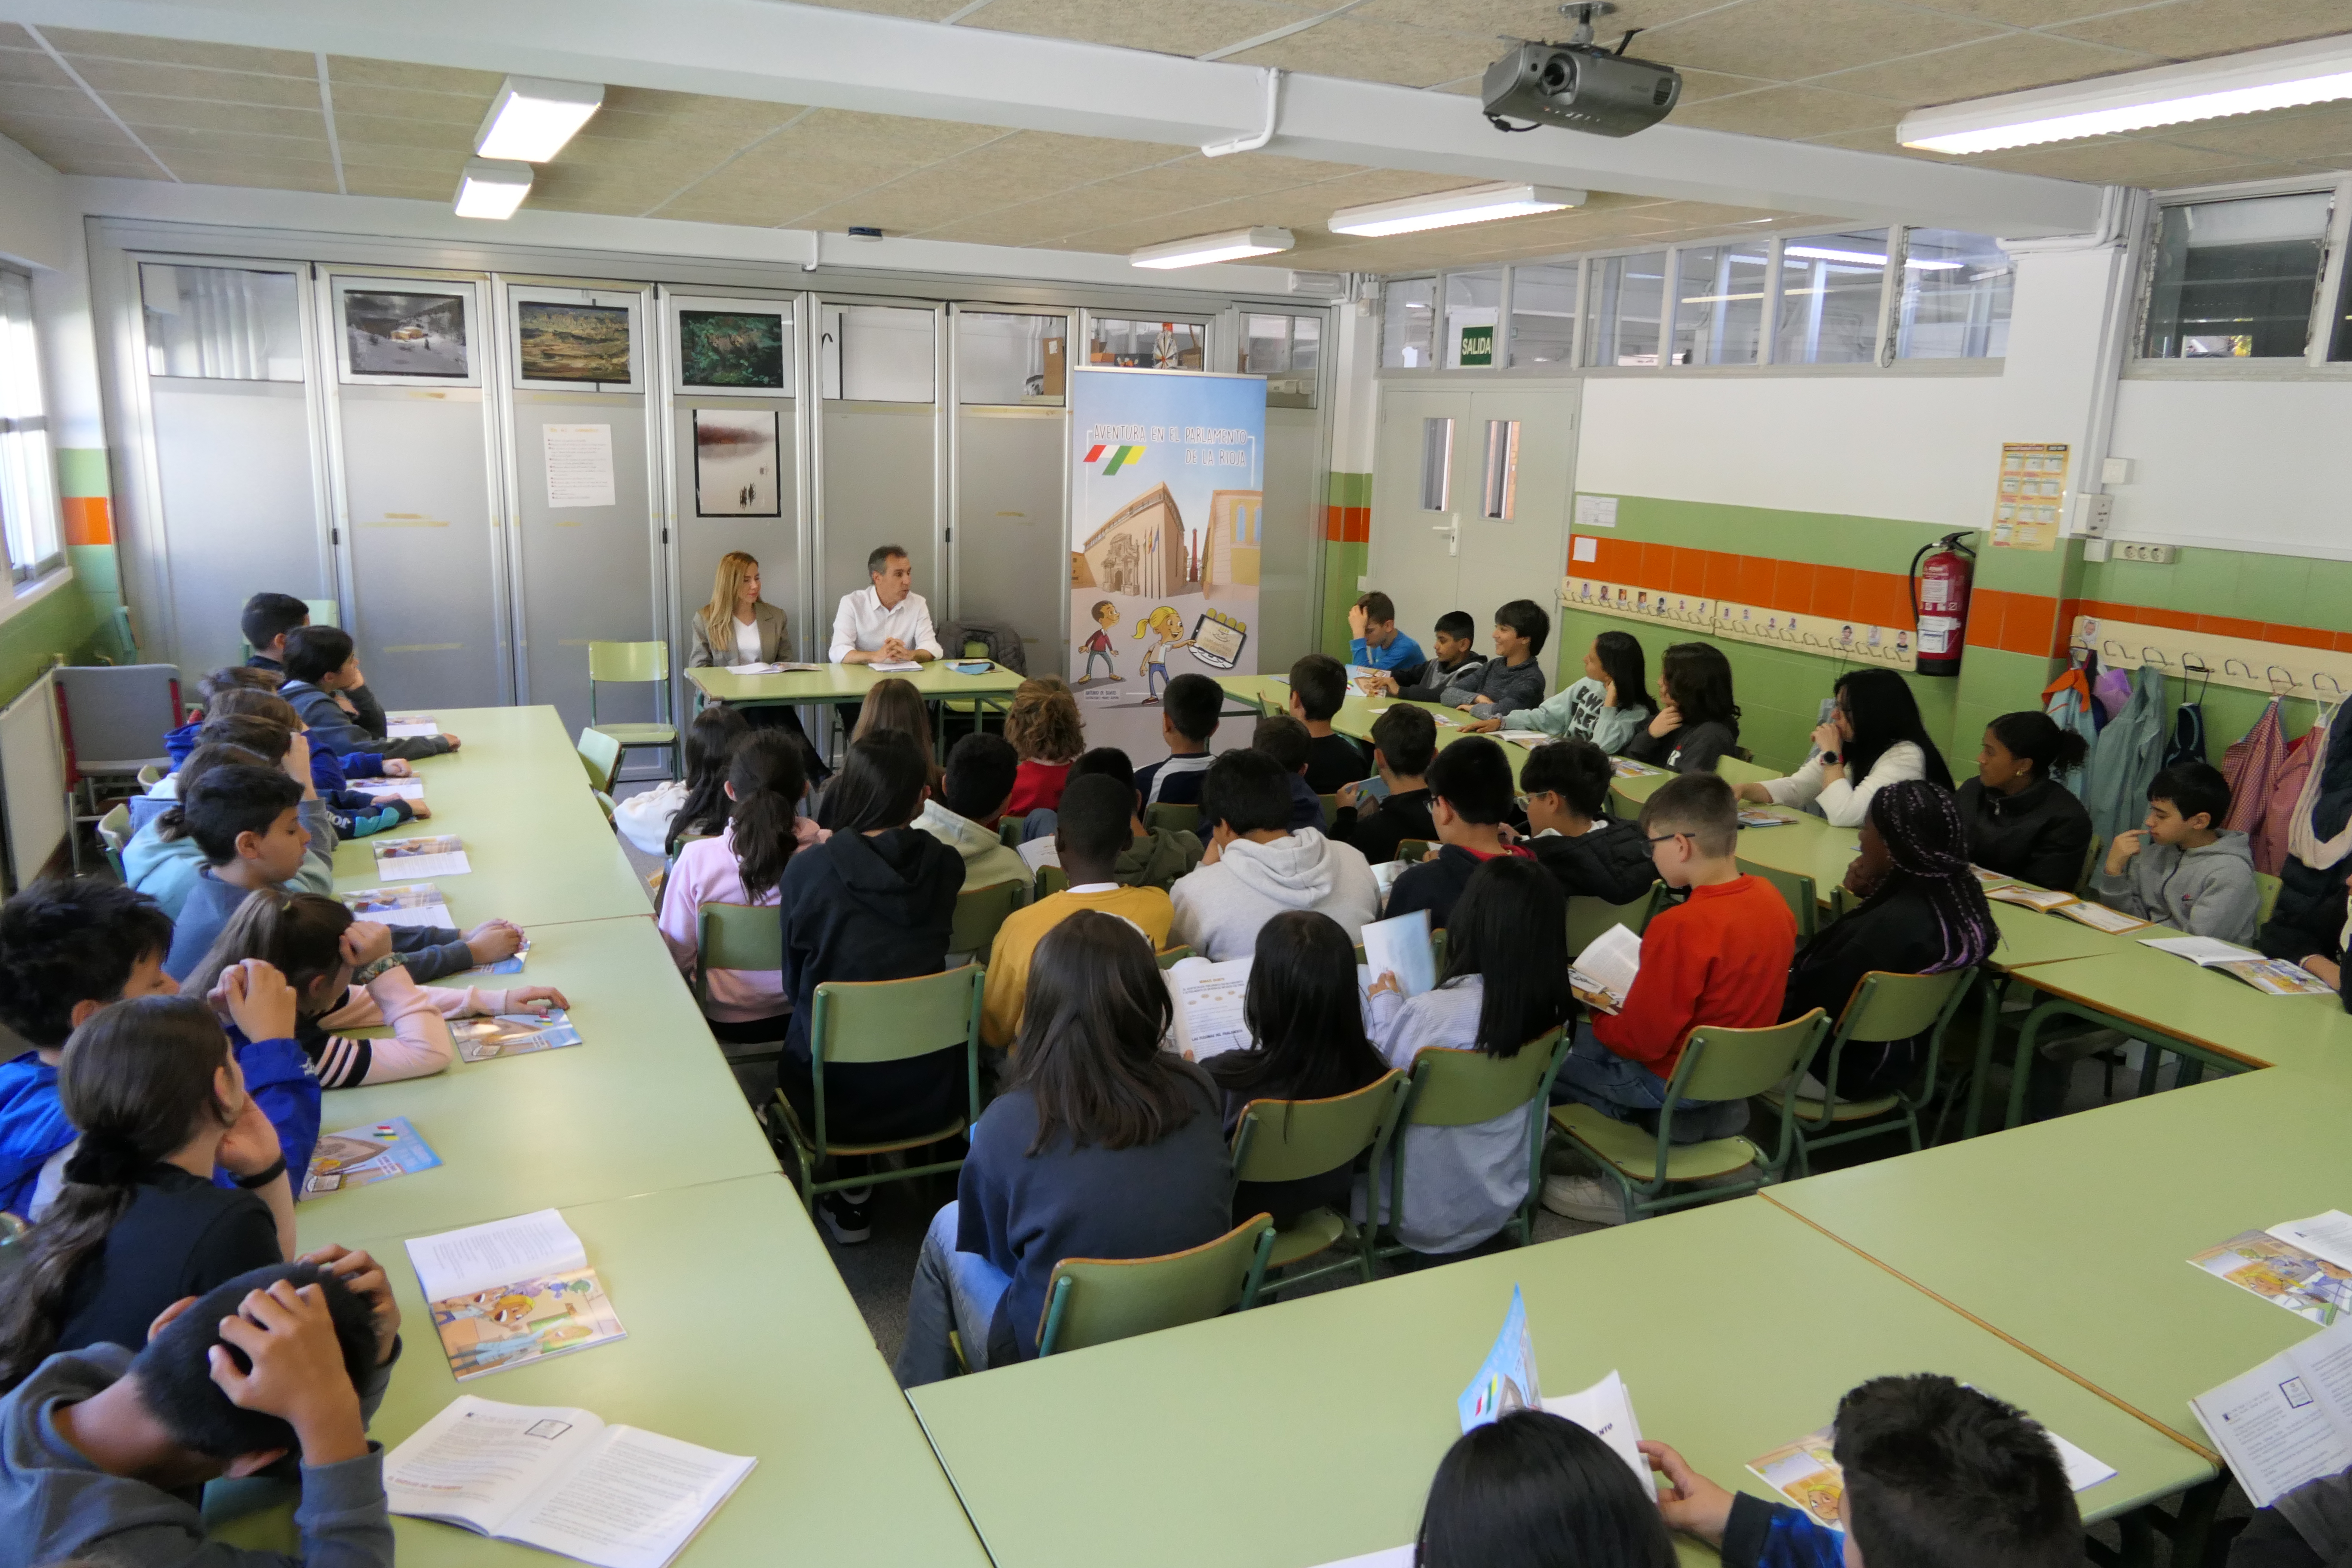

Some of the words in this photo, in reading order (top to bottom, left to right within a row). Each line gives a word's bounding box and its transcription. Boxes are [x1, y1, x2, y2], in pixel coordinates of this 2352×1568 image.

[1462, 337, 1491, 355] SALIDA
[1094, 425, 1146, 441] AVENTURA
[1152, 427, 1164, 442] EN
[1170, 427, 1179, 442] EL
[1185, 427, 1246, 444] PARLAMENTO
[1186, 449, 1197, 464] DE
[1203, 450, 1213, 465] LA
[1220, 450, 1246, 466] RIOJA
